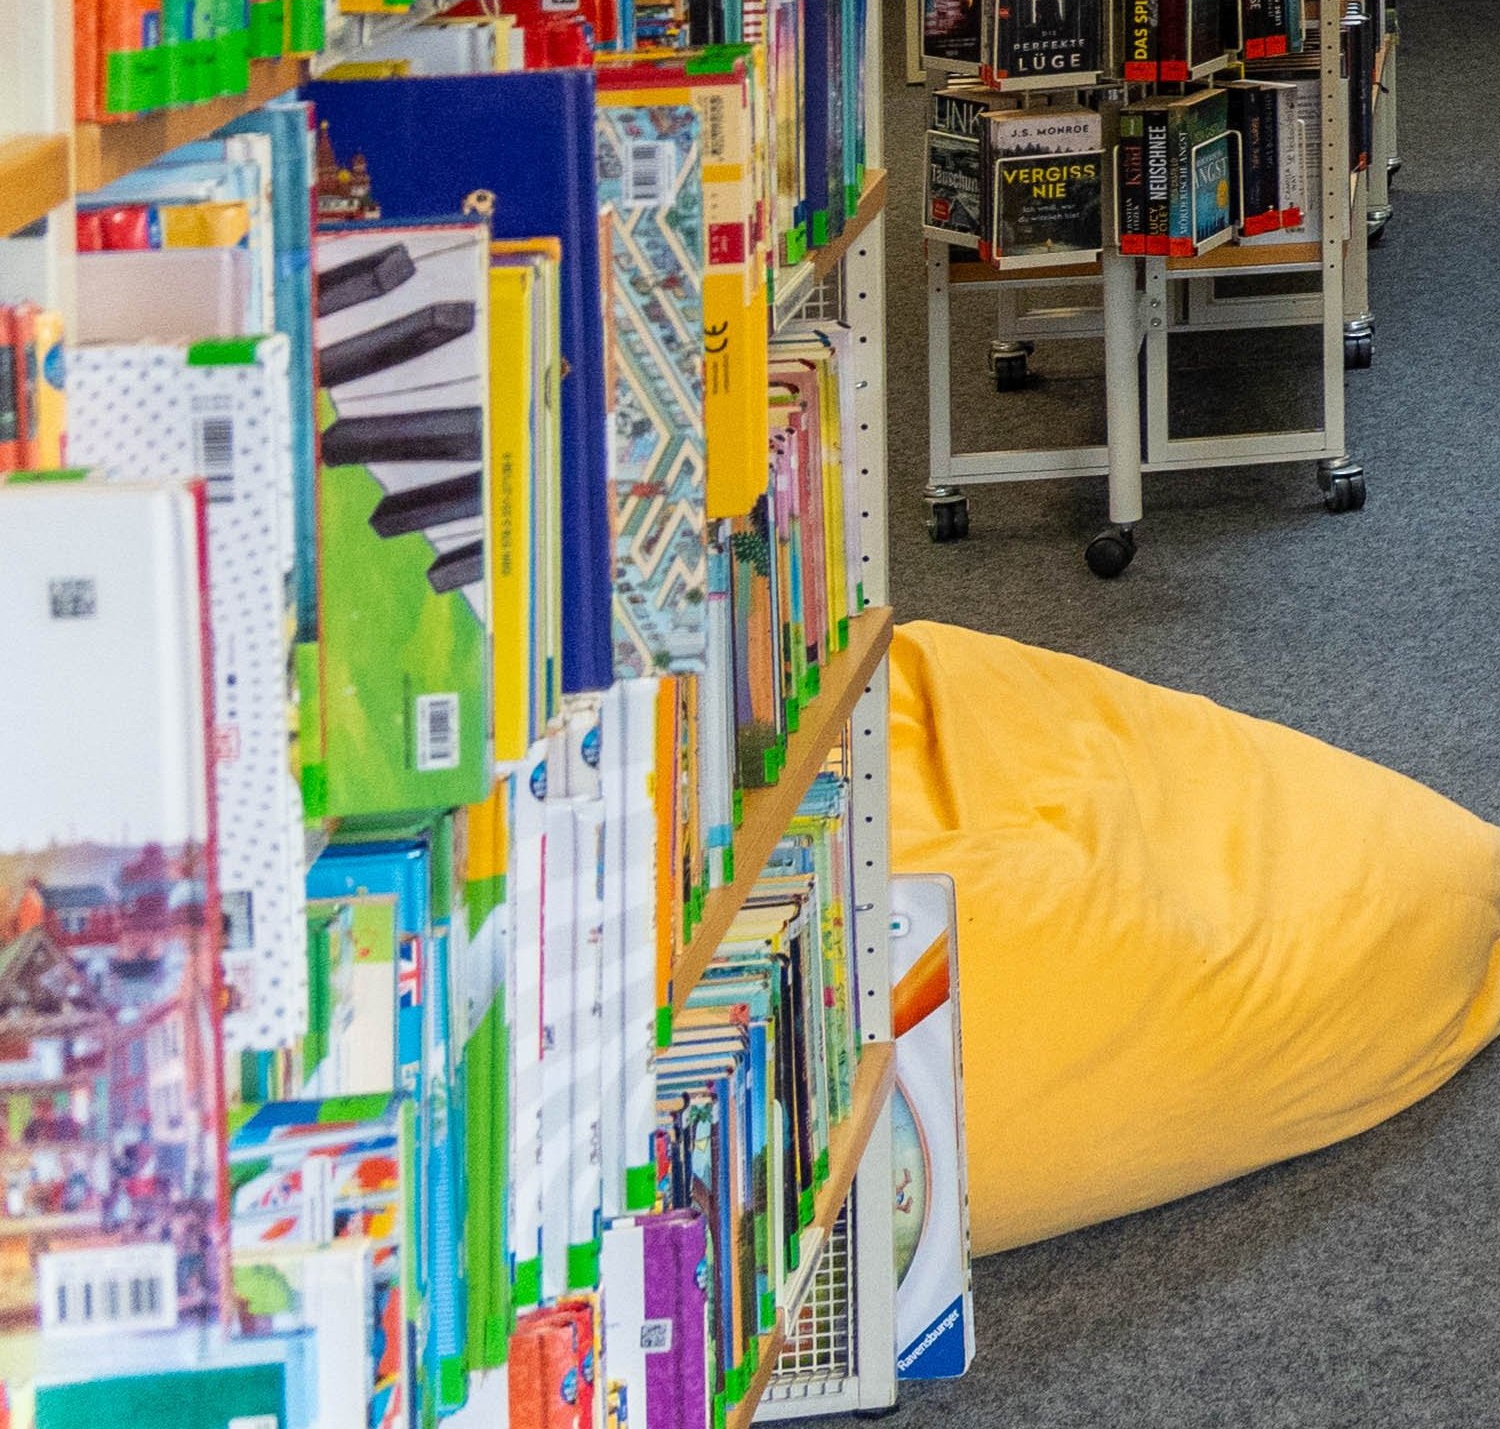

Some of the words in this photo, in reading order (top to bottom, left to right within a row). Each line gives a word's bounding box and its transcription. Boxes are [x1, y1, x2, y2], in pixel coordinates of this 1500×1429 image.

[1134, 28, 1148, 60] DAS
[1018, 53, 1081, 71] LÜGE
[1037, 124, 1089, 136] MONROE
[1150, 125, 1168, 202] NEUSCHNEE
[1003, 164, 1096, 184] VERGISS
[1032, 183, 1066, 198] NIE
[897, 1305, 962, 1375] Ravensburger
